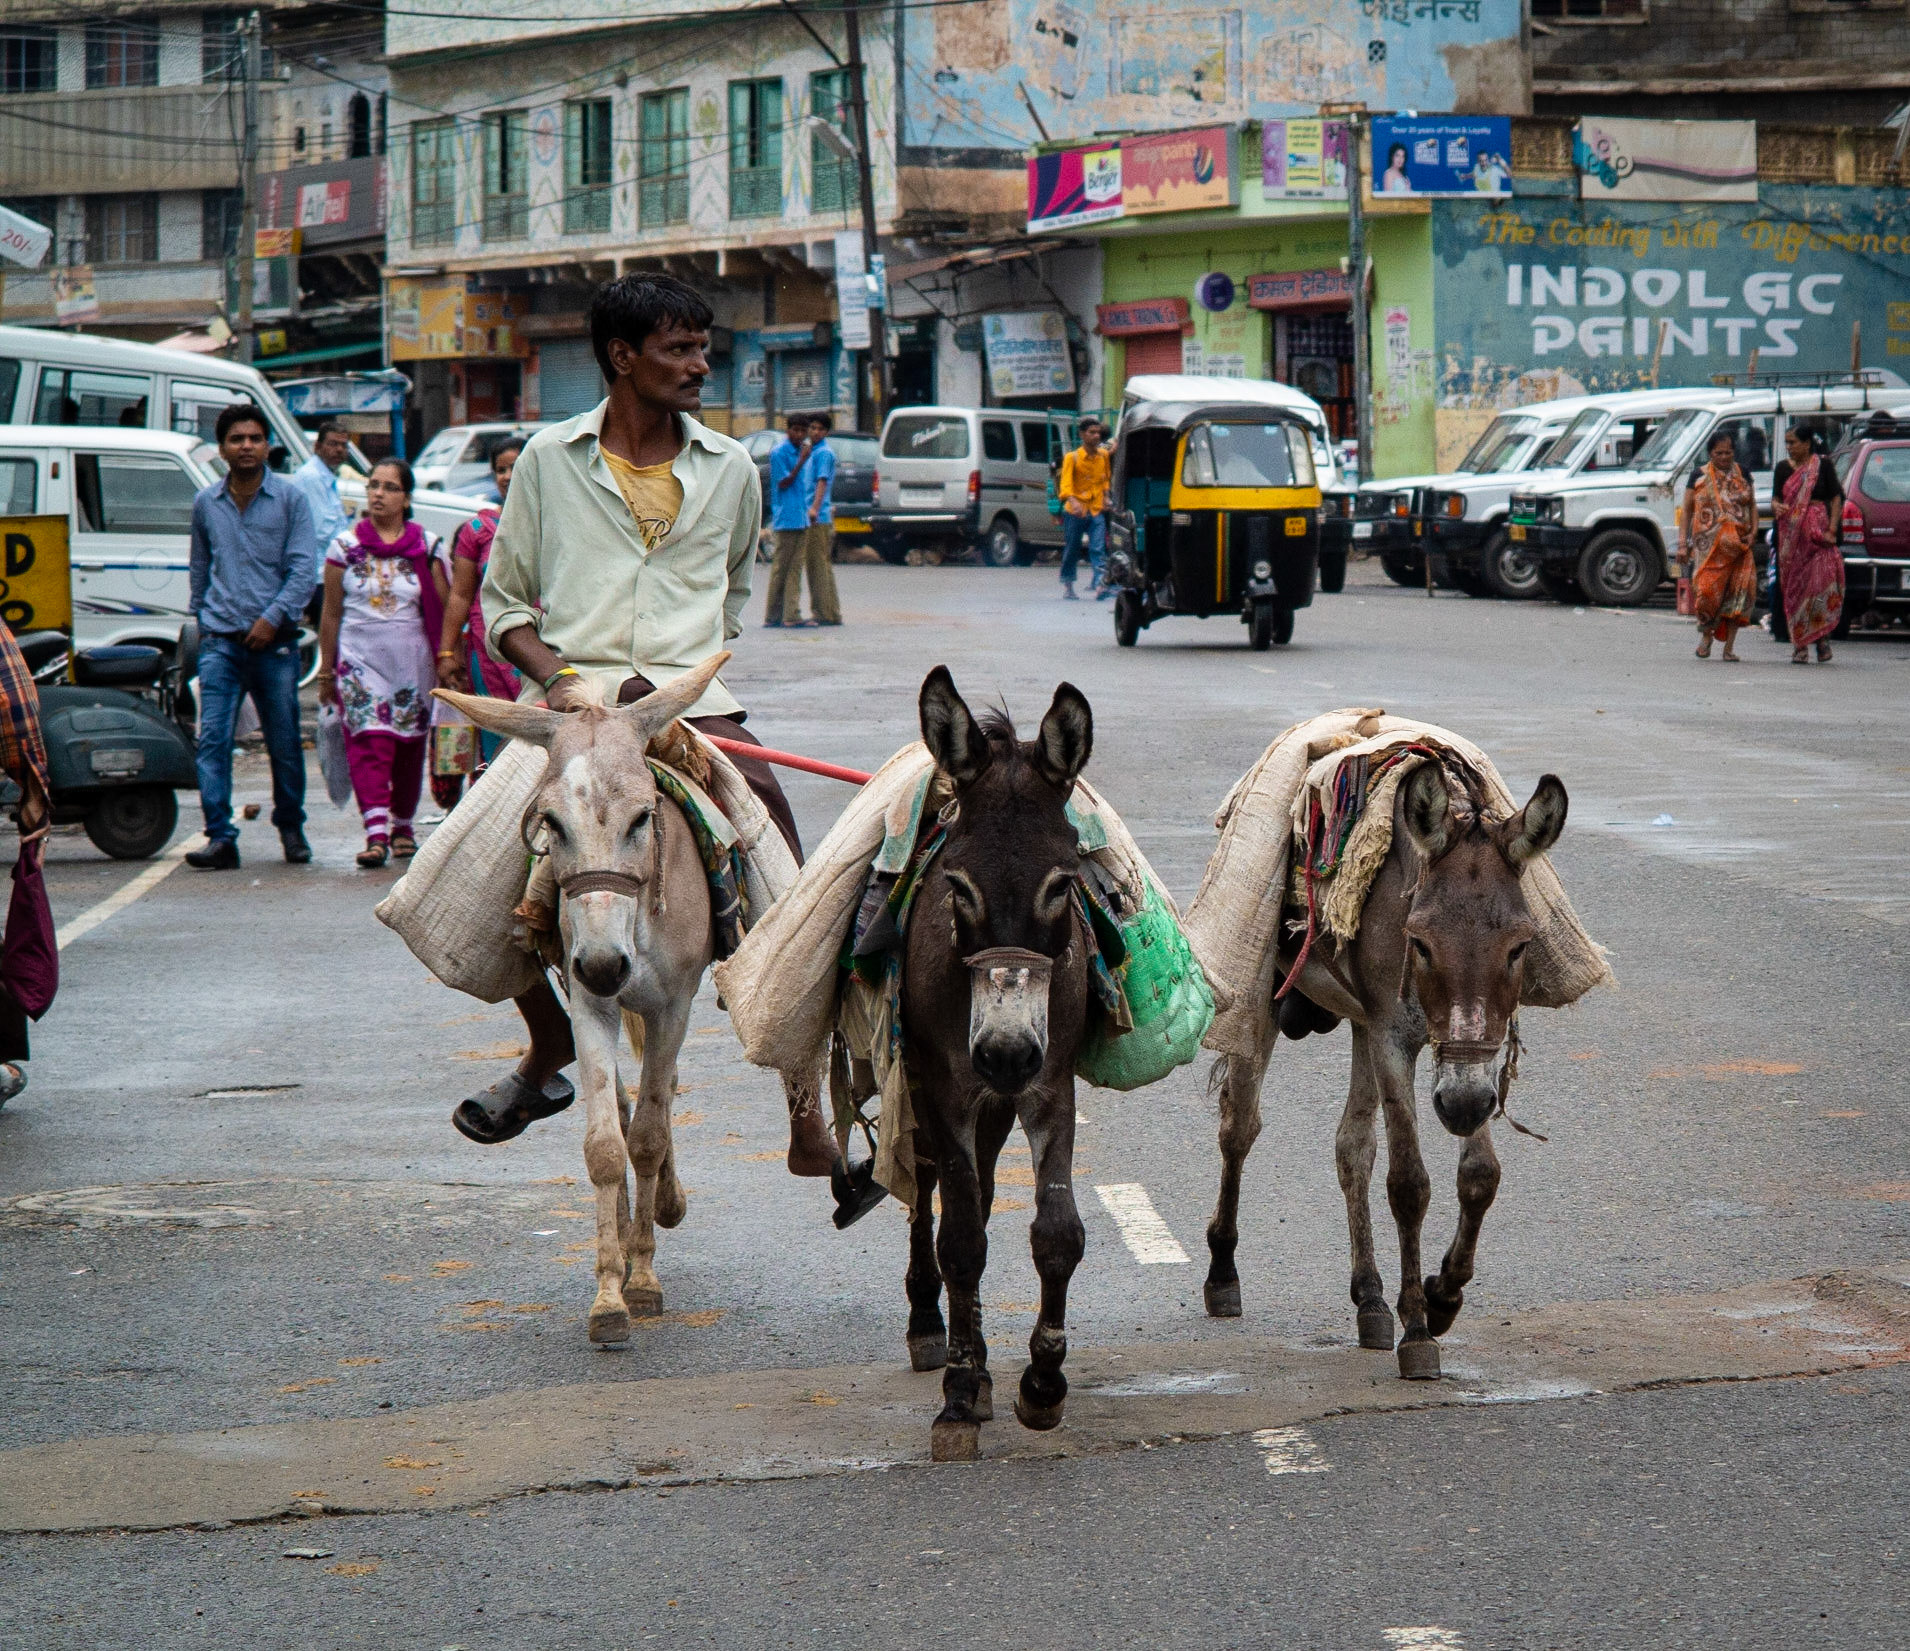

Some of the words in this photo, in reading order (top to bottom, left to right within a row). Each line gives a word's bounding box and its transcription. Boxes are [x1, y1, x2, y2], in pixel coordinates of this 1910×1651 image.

[1087, 171, 1118, 192] Berger
[1478, 211, 1536, 246] The
[1549, 217, 1650, 258] Coating
[1531, 315, 1804, 358] PAINTS
